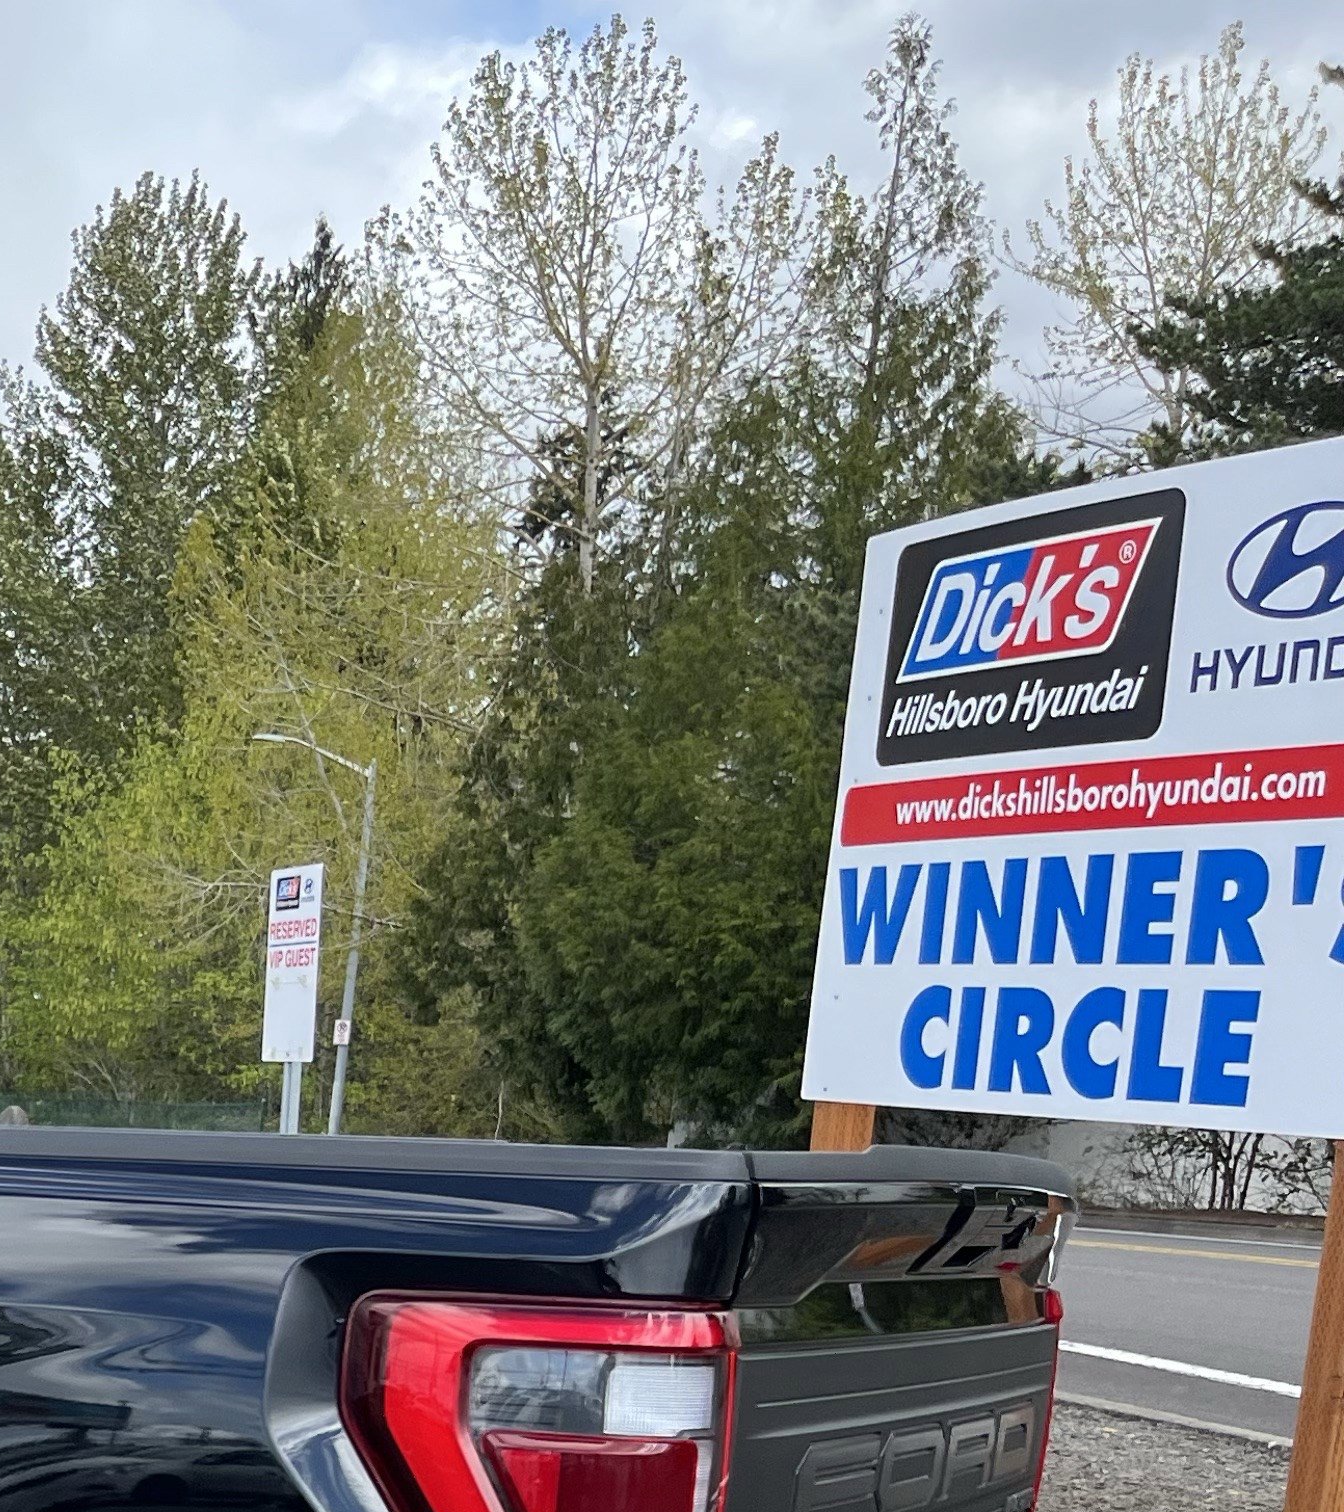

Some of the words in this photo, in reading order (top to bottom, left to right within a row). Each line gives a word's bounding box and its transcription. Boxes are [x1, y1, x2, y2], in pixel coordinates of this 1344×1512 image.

[915, 544, 1120, 662] Dick's
[886, 690, 1006, 738] Hillsboro
[1010, 665, 1149, 732] Hyundai
[896, 763, 1326, 824] www.dickshillsborohyundai.com
[270, 918, 317, 939] RESERVED
[839, 845, 1344, 966] WINNER'
[269, 949, 283, 968] VIP
[285, 947, 317, 968] GUEST
[900, 985, 1262, 1107] CIRCLE
